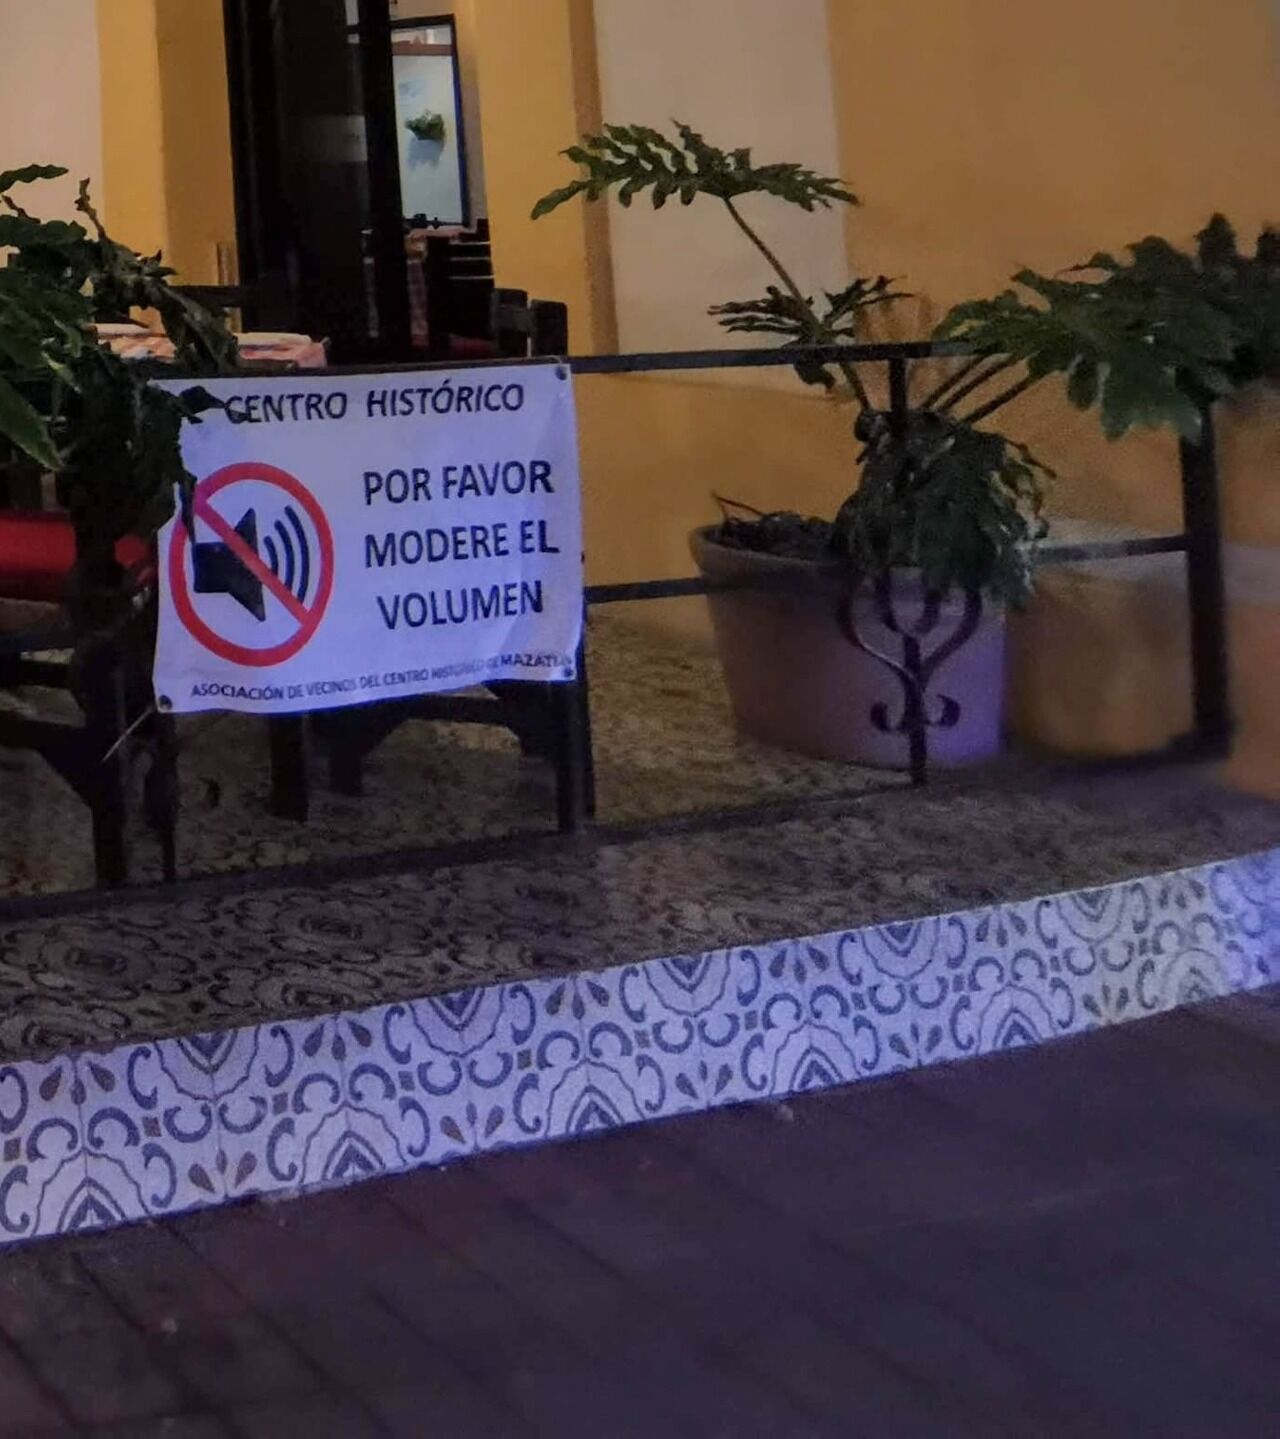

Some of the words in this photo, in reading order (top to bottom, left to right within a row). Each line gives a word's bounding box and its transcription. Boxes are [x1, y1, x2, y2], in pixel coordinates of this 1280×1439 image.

[225, 392, 348, 424] CENTRO
[366, 378, 525, 418] HISTÓRICO
[363, 468, 433, 506] POR
[442, 460, 556, 499] FAVOR
[364, 522, 510, 569] MODERE
[519, 519, 561, 555] EL
[377, 580, 544, 631] VOLUMEN
[191, 682, 284, 701] ASOCIACIÓN
[288, 684, 304, 700] DE
[306, 676, 357, 697] VECINOS
[360, 673, 381, 691] DEL
[383, 667, 429, 687] CENTRO
